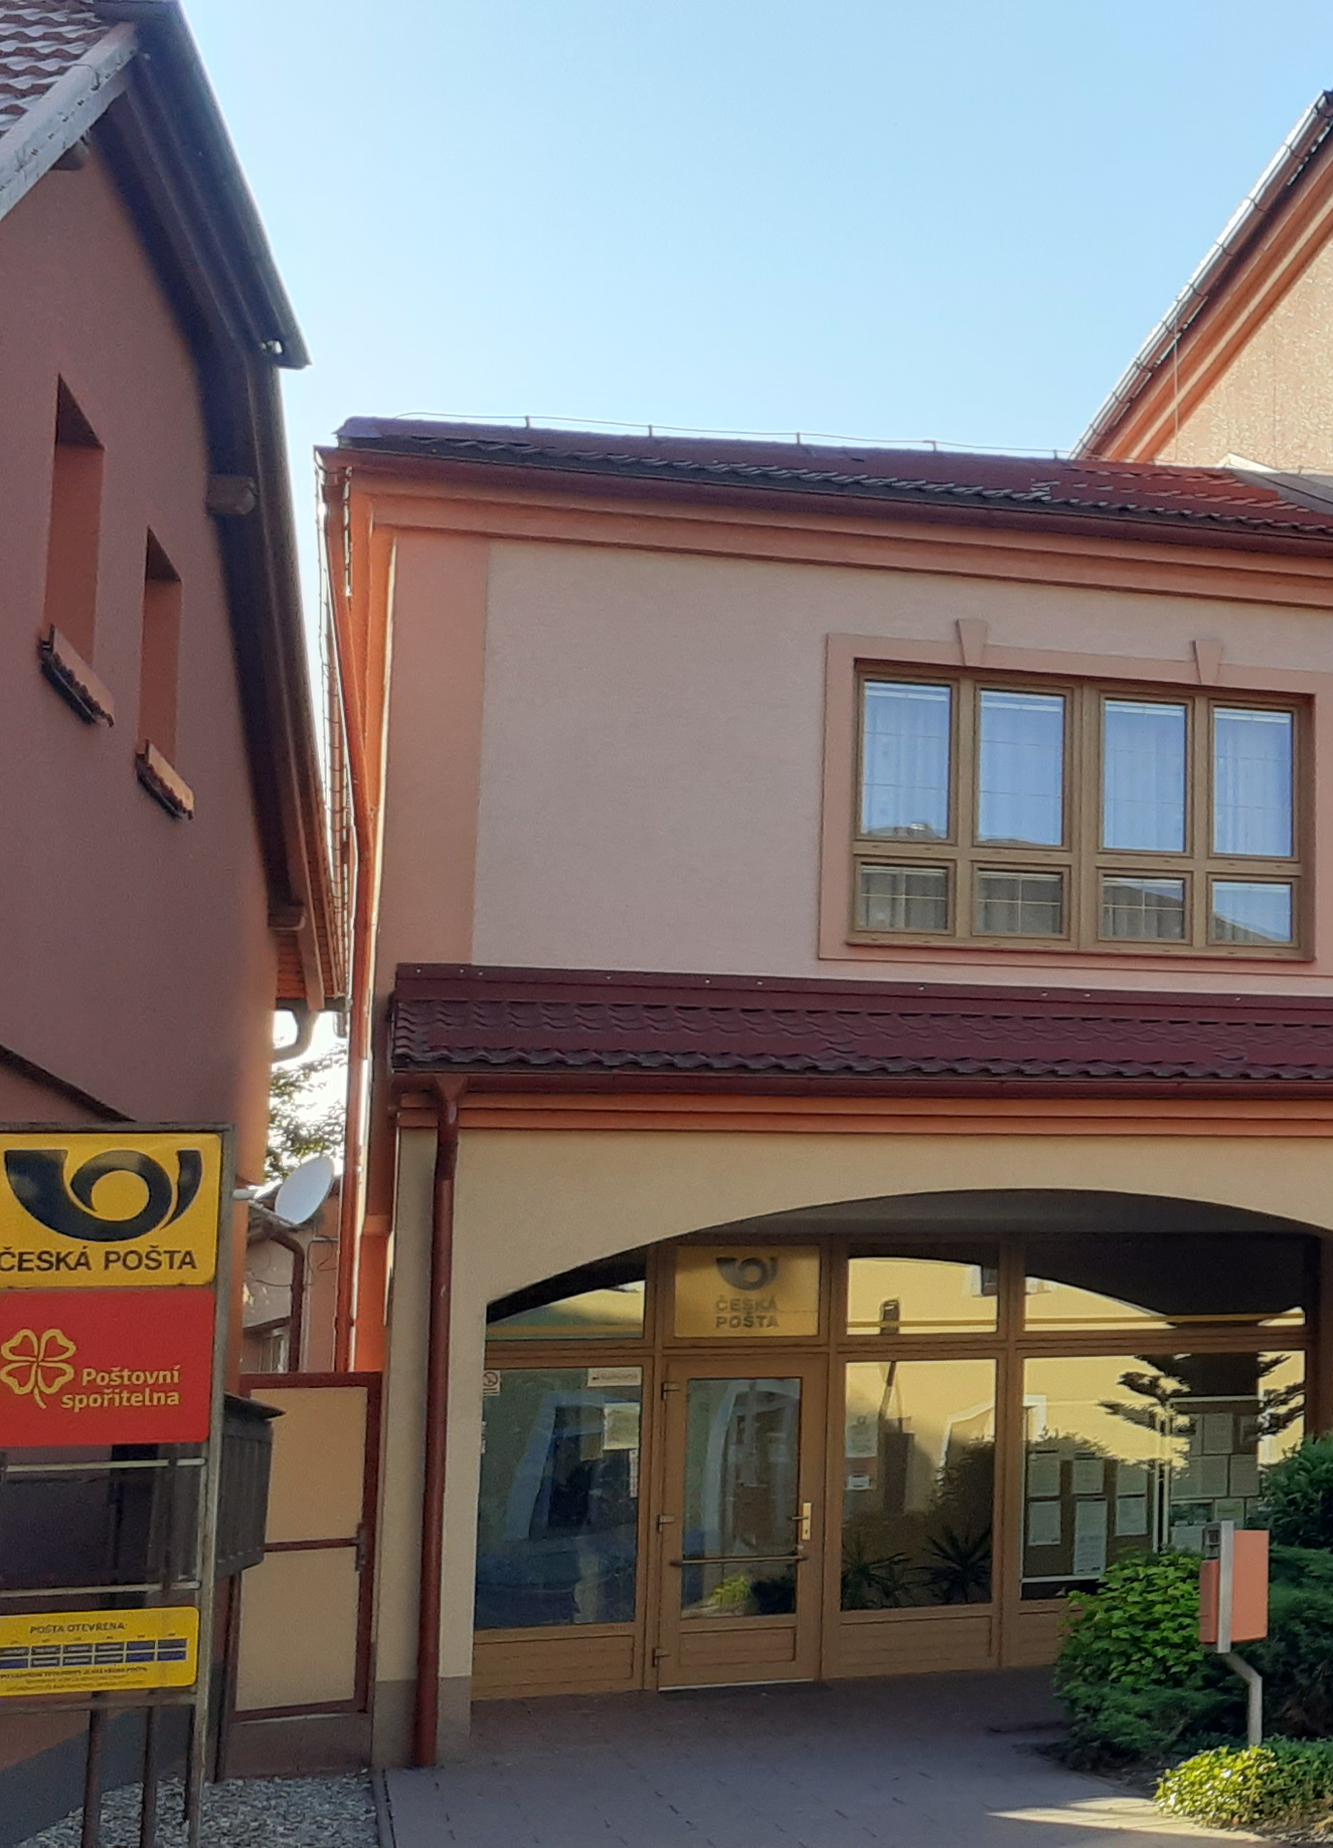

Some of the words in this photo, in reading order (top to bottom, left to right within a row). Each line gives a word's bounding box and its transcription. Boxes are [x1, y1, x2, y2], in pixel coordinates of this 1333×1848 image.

[0, 1246, 91, 1272] ČESKÁ
[104, 1245, 197, 1271] POŠTA
[716, 1295, 777, 1312] ČESKÁ
[716, 1312, 778, 1328] POŠTA
[82, 1365, 181, 1386] Poštovní
[61, 1389, 180, 1412] spořitelna
